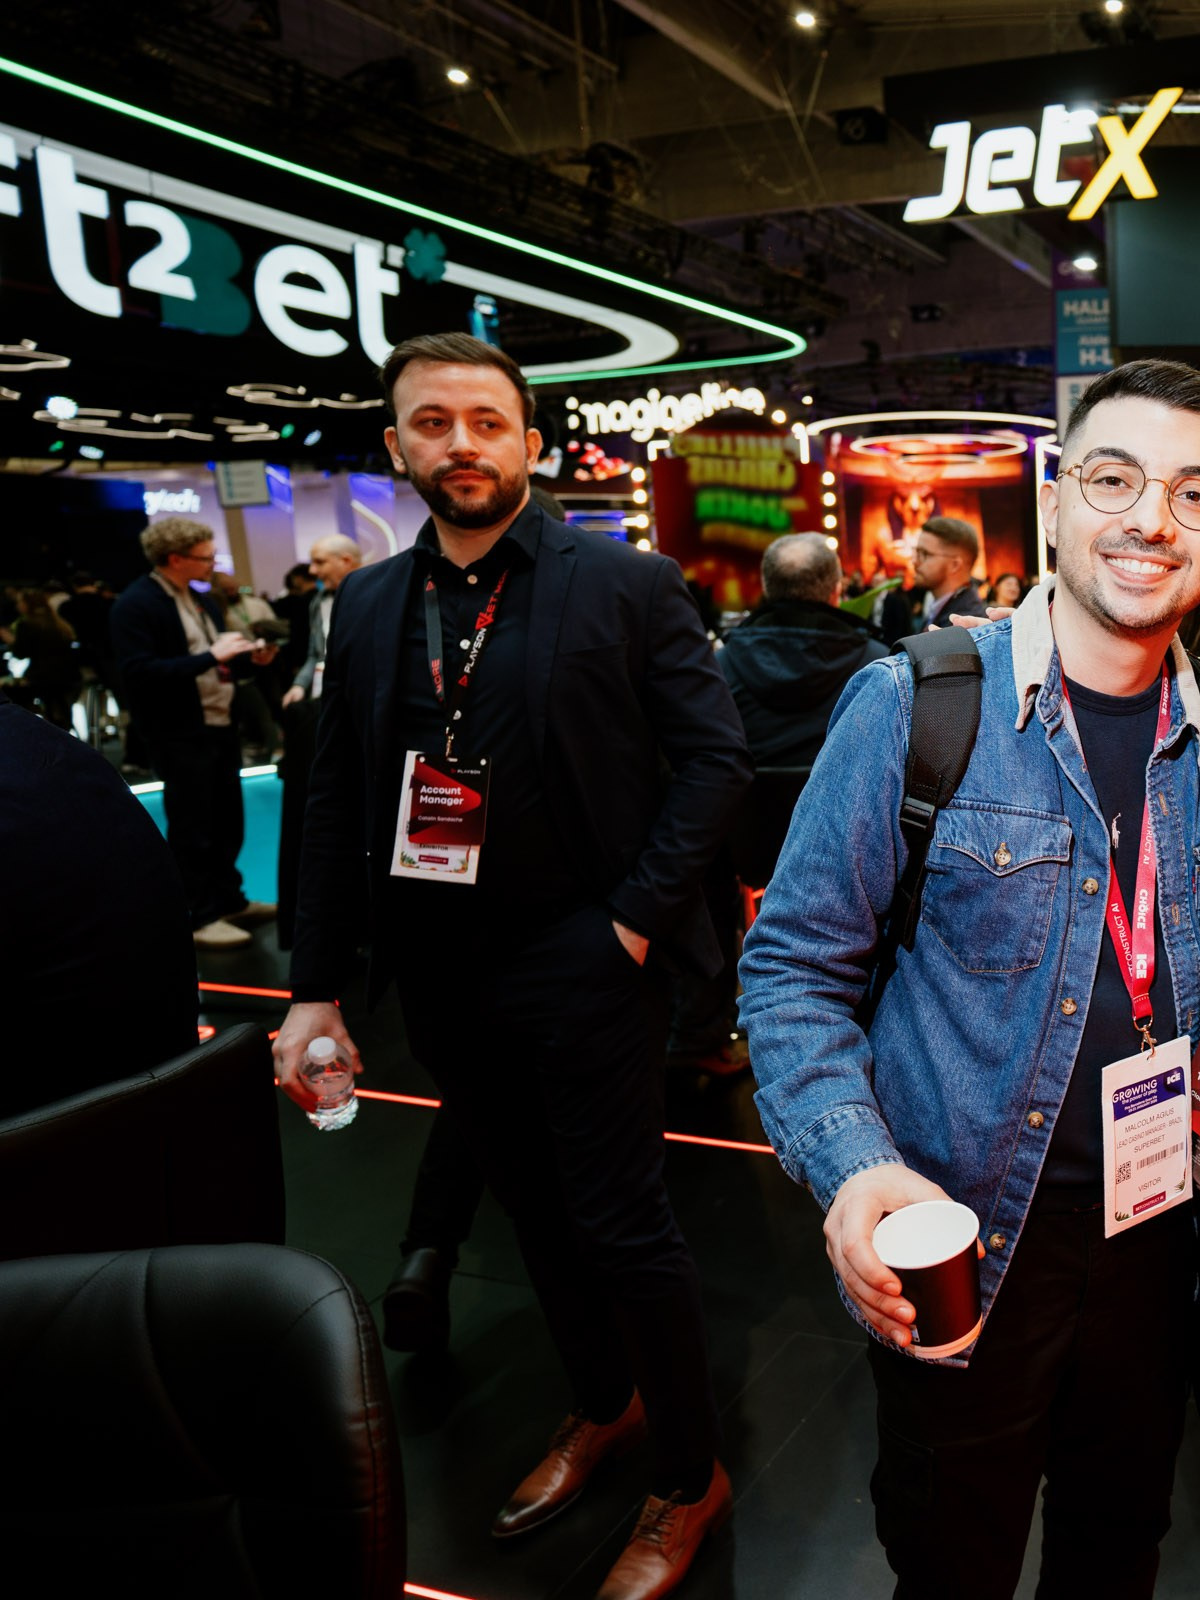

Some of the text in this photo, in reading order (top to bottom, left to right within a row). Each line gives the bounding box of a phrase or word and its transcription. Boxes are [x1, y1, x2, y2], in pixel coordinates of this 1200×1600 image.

[902, 87, 1184, 223] JetX
[464, 628, 487, 673] PLAYSON
[420, 785, 461, 795] Account
[419, 795, 464, 806] Manager
[1136, 888, 1148, 929] CHOICE
[1135, 954, 1148, 980] ICE
[1167, 1072, 1181, 1085] ICE
[1112, 1078, 1157, 1104] GROWING
[1125, 1115, 1155, 1133] MALCOLM
[1134, 1134, 1166, 1153] SUPERBET
[1138, 1176, 1162, 1192] VISITOR
